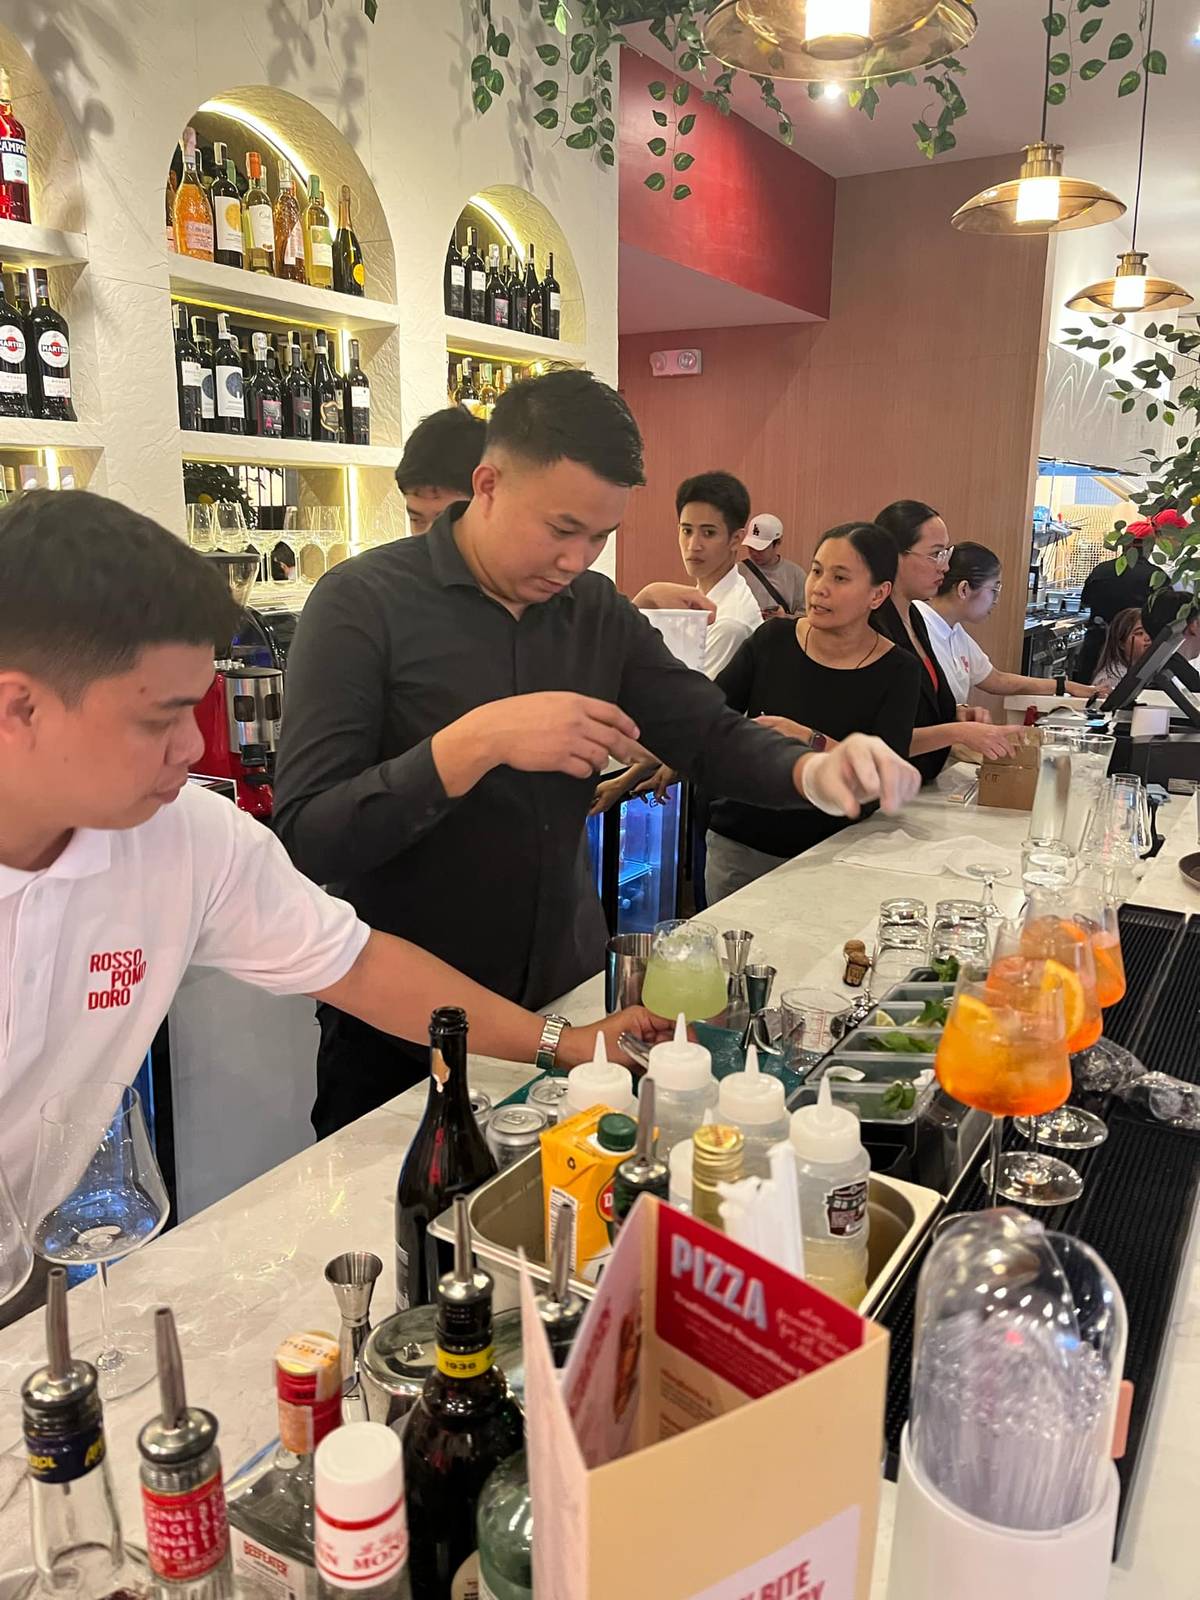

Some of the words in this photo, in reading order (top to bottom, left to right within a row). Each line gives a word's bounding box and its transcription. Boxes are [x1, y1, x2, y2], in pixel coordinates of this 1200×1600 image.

[89, 948, 143, 974] ROSSO
[111, 960, 147, 990] POMO
[87, 987, 131, 1011] DORO
[670, 1232, 769, 1331] PIZZA
